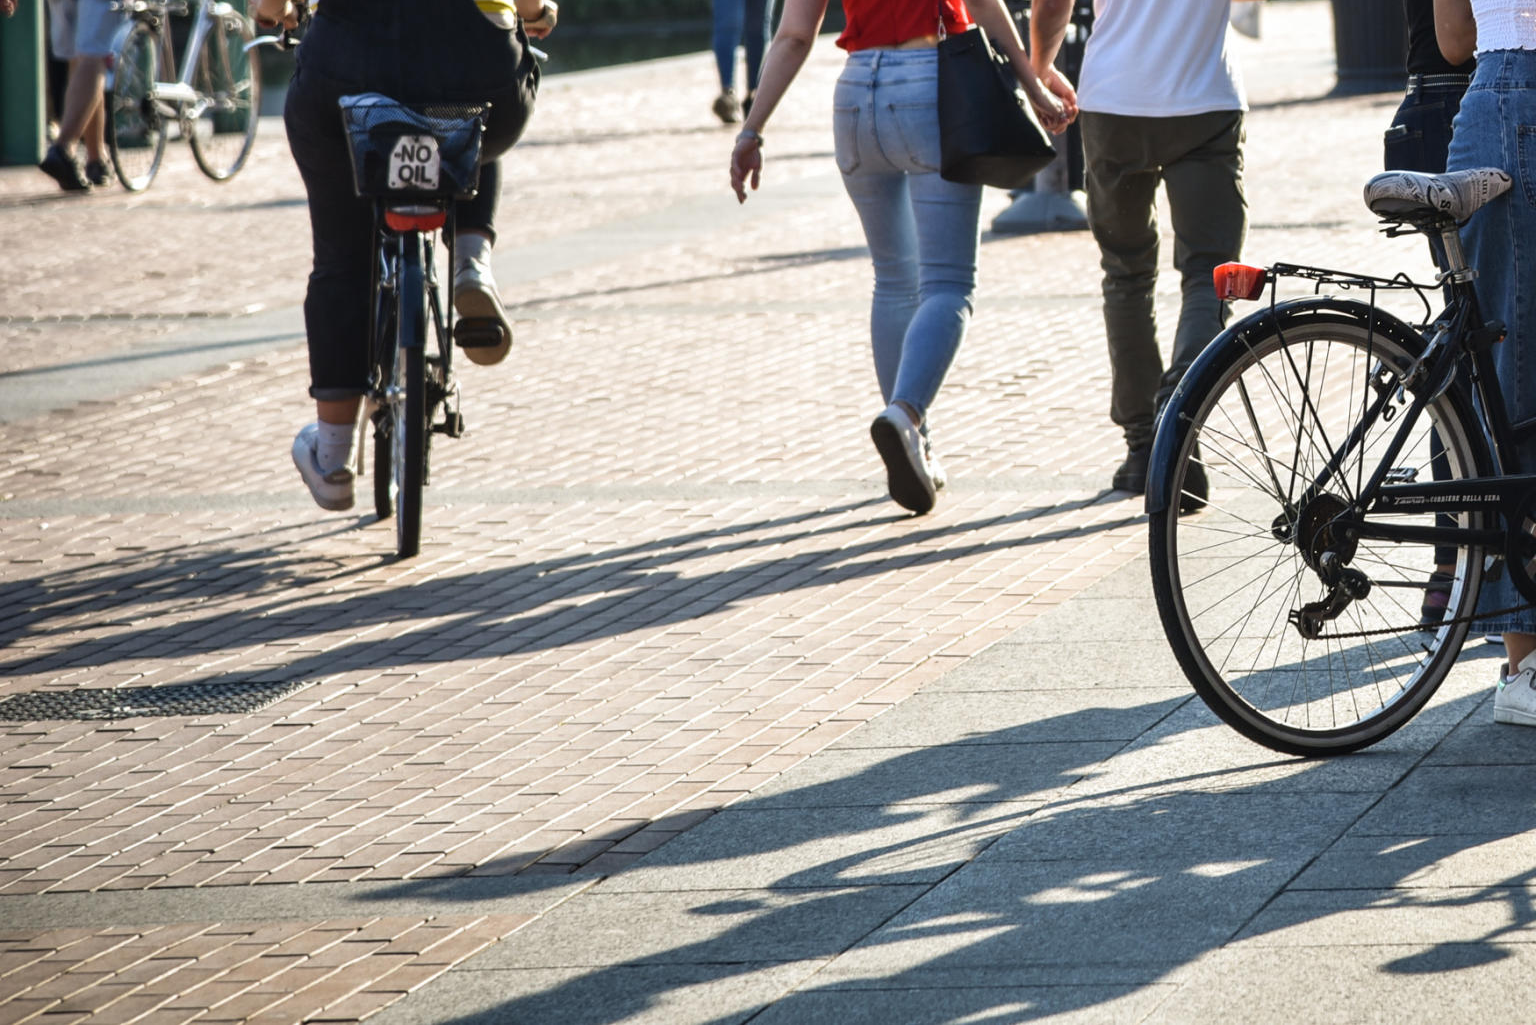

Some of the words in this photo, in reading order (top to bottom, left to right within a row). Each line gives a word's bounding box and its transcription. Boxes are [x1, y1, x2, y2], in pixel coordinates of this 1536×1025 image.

[401, 145, 432, 163] NO
[398, 165, 433, 183] OIL
[1430, 495, 1460, 503] CORRIERE
[1462, 494, 1482, 502] DELLA
